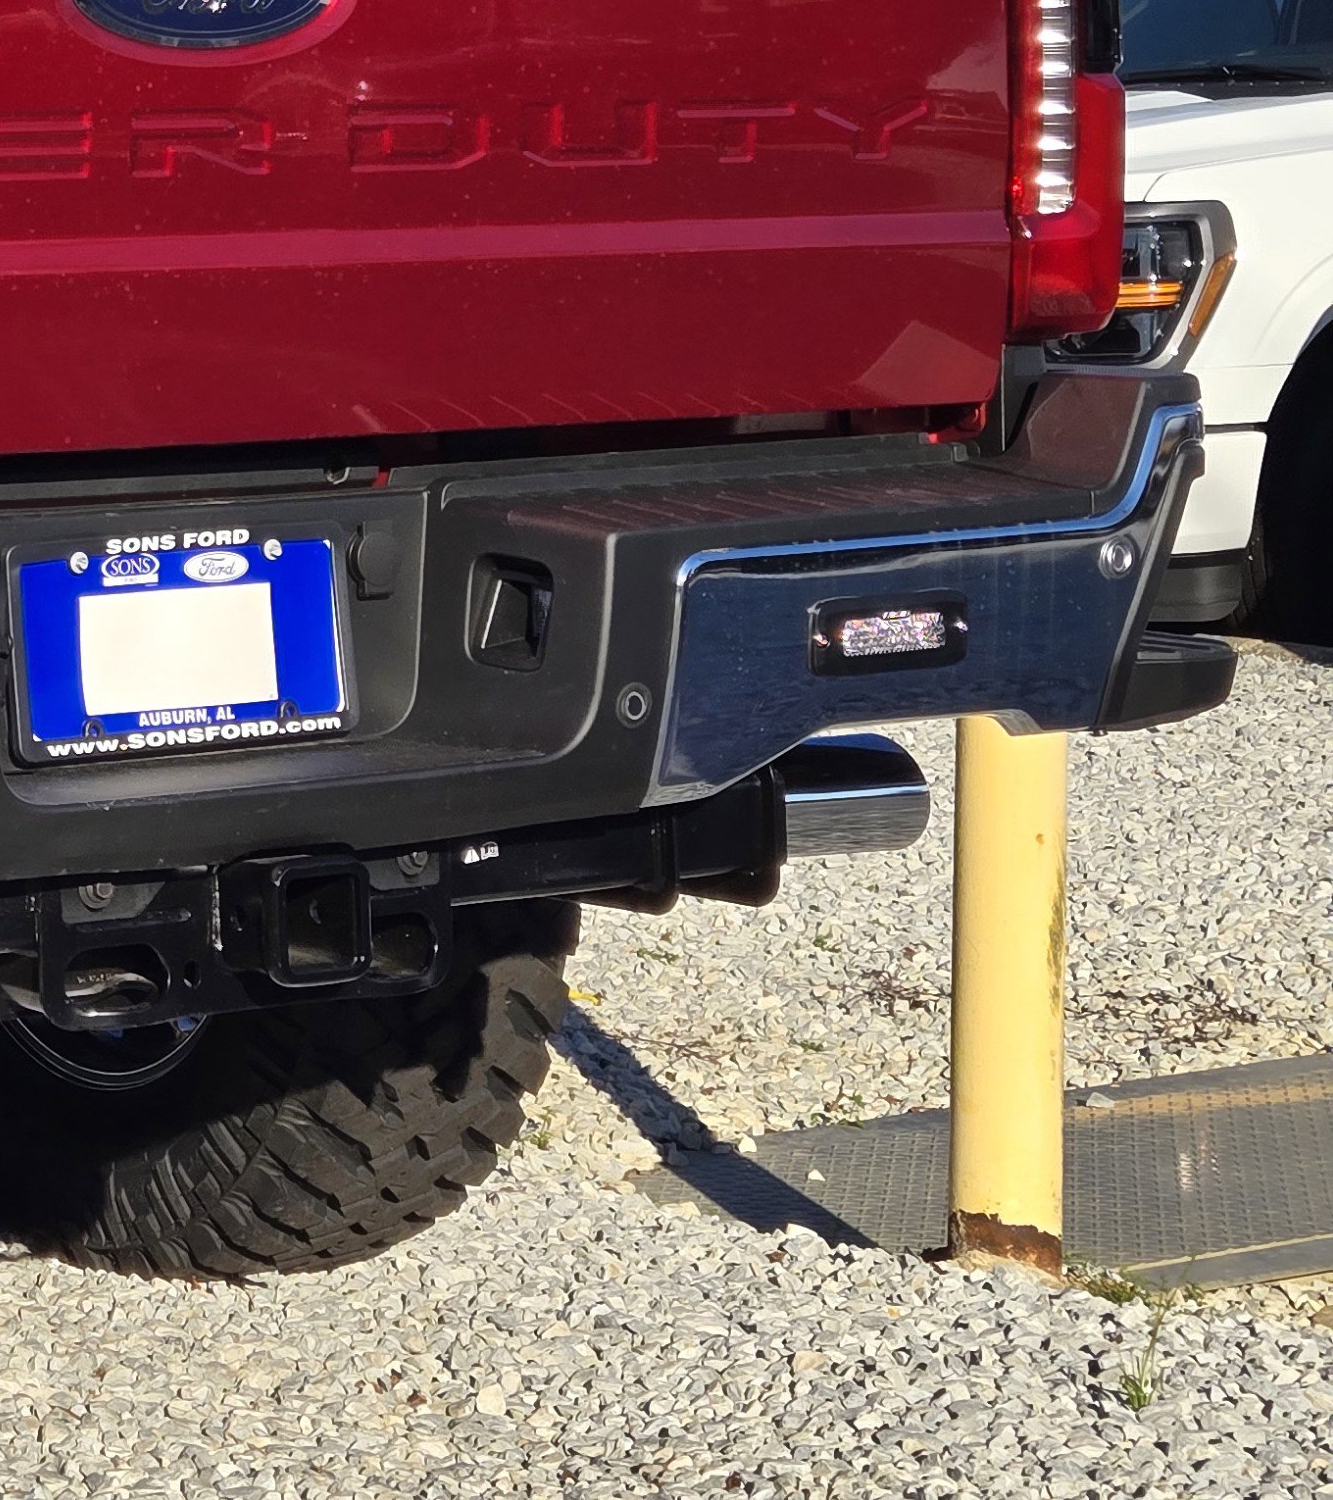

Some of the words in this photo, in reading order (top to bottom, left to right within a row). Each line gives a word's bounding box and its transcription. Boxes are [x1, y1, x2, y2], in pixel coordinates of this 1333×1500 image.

[346, 99, 929, 174] DUTY
[106, 534, 176, 555] SONS
[183, 529, 249, 549] FORD
[110, 556, 151, 575] SONS
[199, 558, 236, 577] Ford
[139, 708, 212, 729] AUBURN,
[216, 706, 235, 721] AL
[46, 716, 341, 757] www.SONSFORD.com
